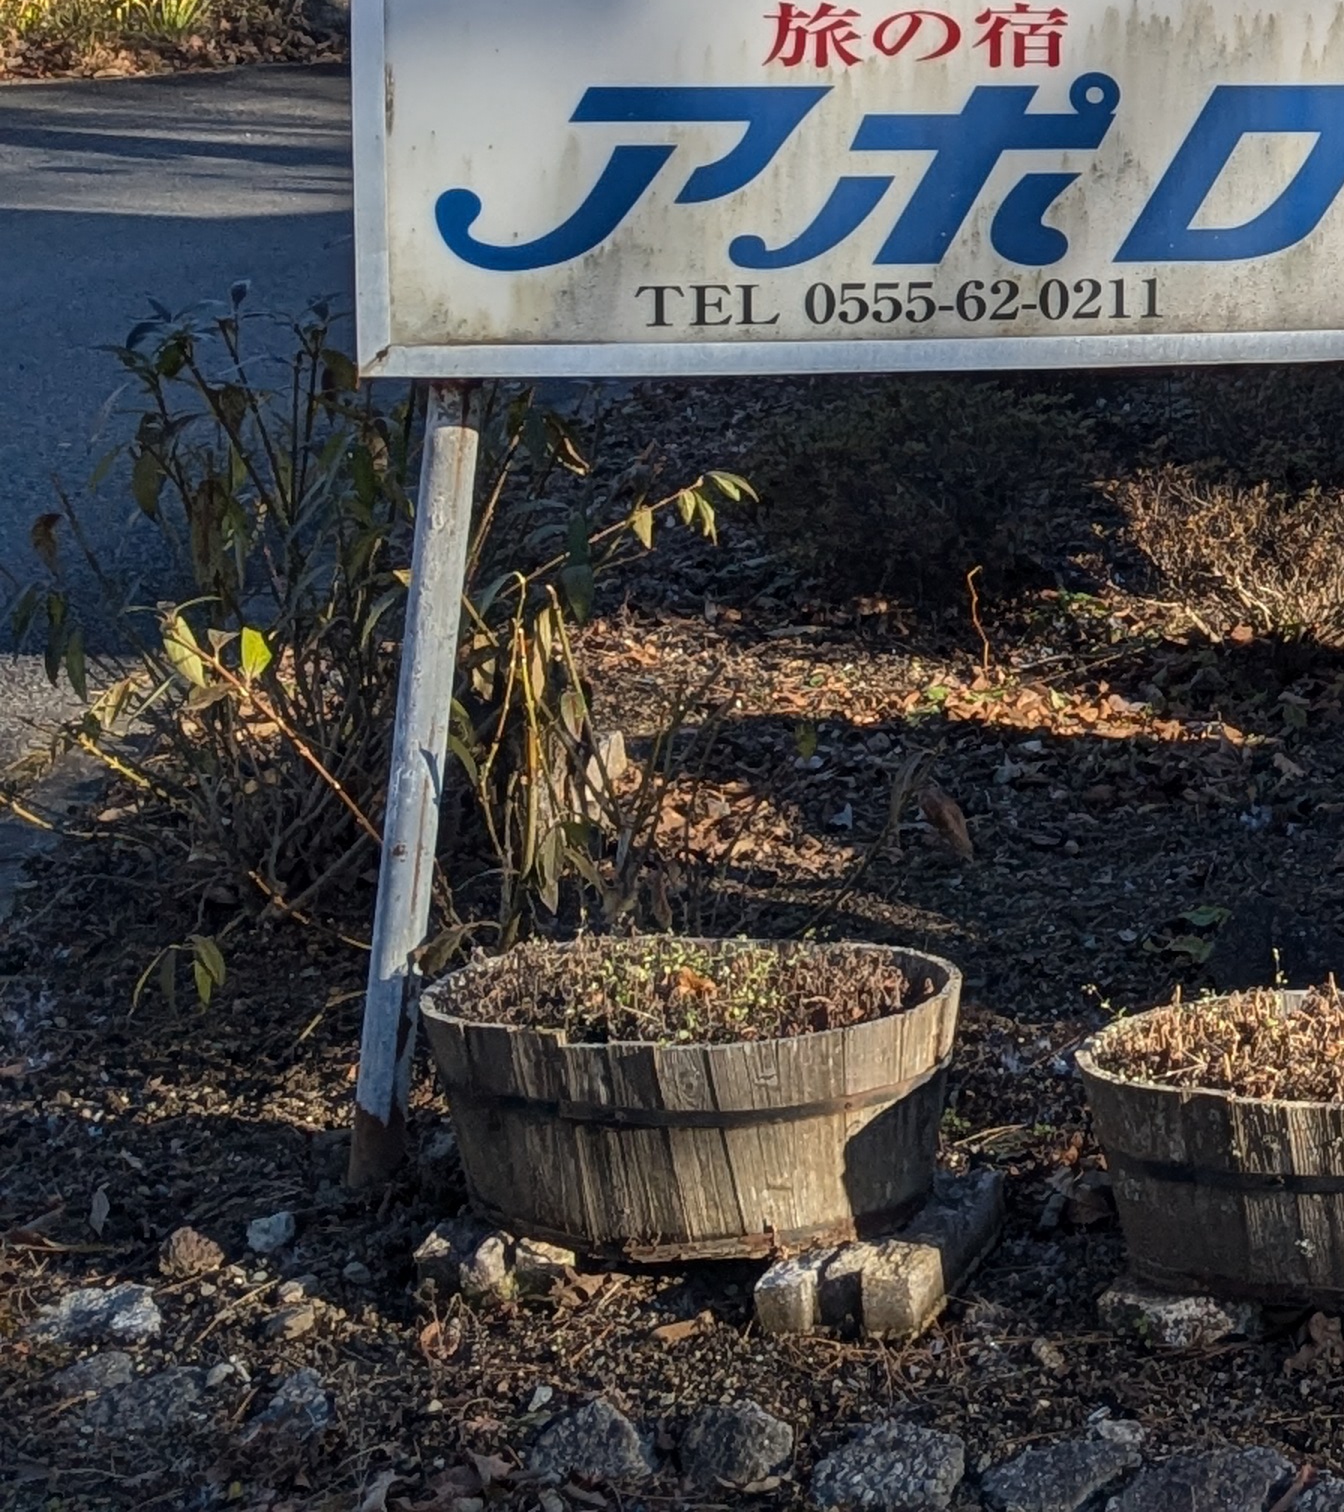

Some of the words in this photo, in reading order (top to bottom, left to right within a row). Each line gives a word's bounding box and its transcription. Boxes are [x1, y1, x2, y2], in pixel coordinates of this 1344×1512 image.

[762, 1, 1070, 69] 旅の宿
[635, 284, 780, 329] TEL
[803, 276, 1163, 326] 0555-62-0211
